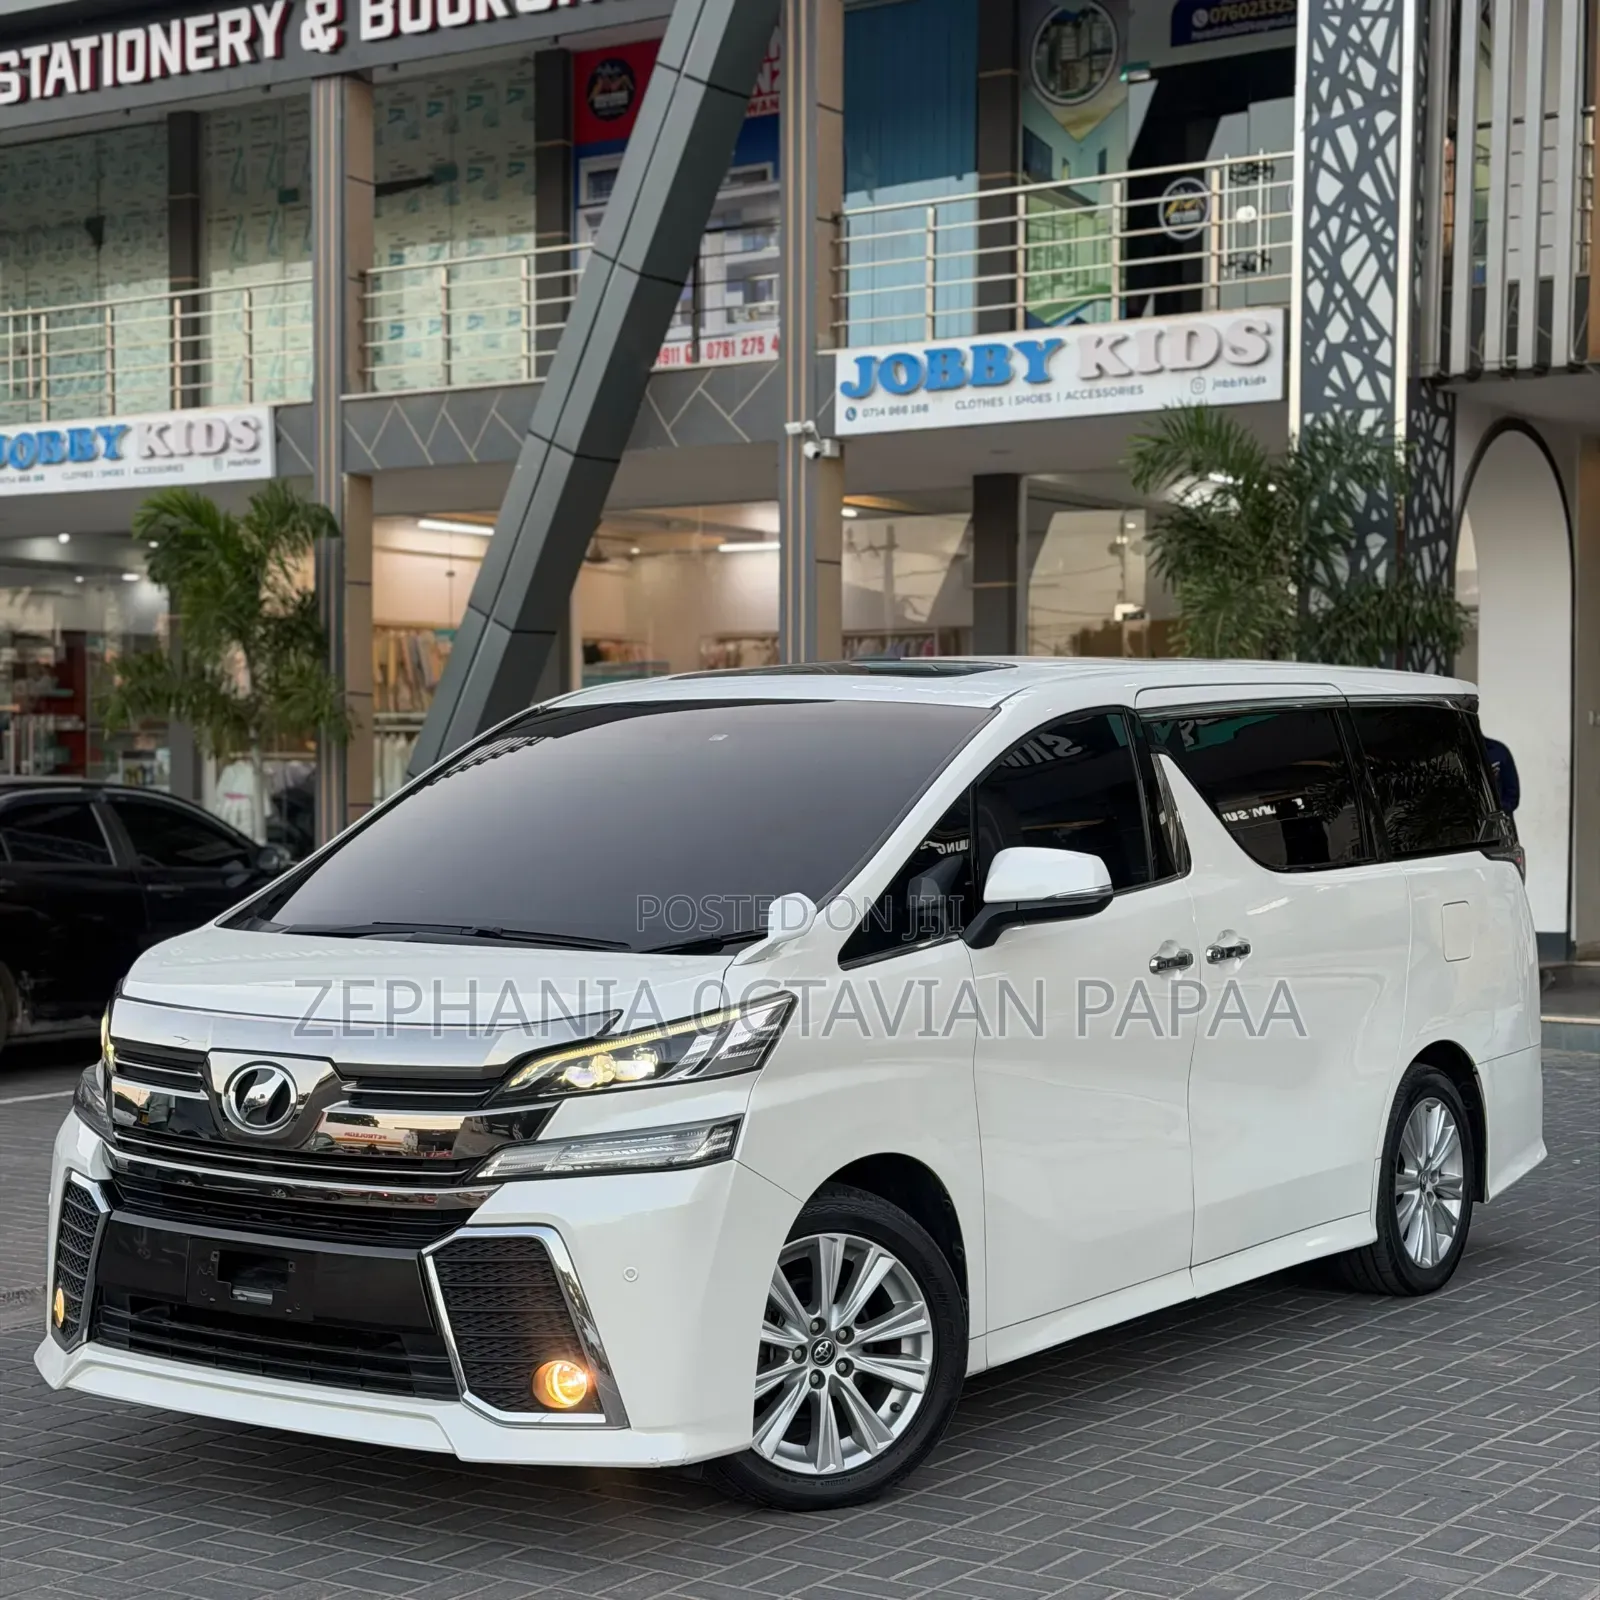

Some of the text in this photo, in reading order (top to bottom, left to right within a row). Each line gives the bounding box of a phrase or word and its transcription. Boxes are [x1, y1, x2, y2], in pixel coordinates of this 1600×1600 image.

[0, 0, 290, 105] STATIONERY
[300, 0, 345, 53] &
[840, 319, 1272, 399] JOBBY KIDS
[954, 384, 1145, 410] CLOTHES SHOES ACCESSORIES
[136, 416, 263, 460] KIDS
